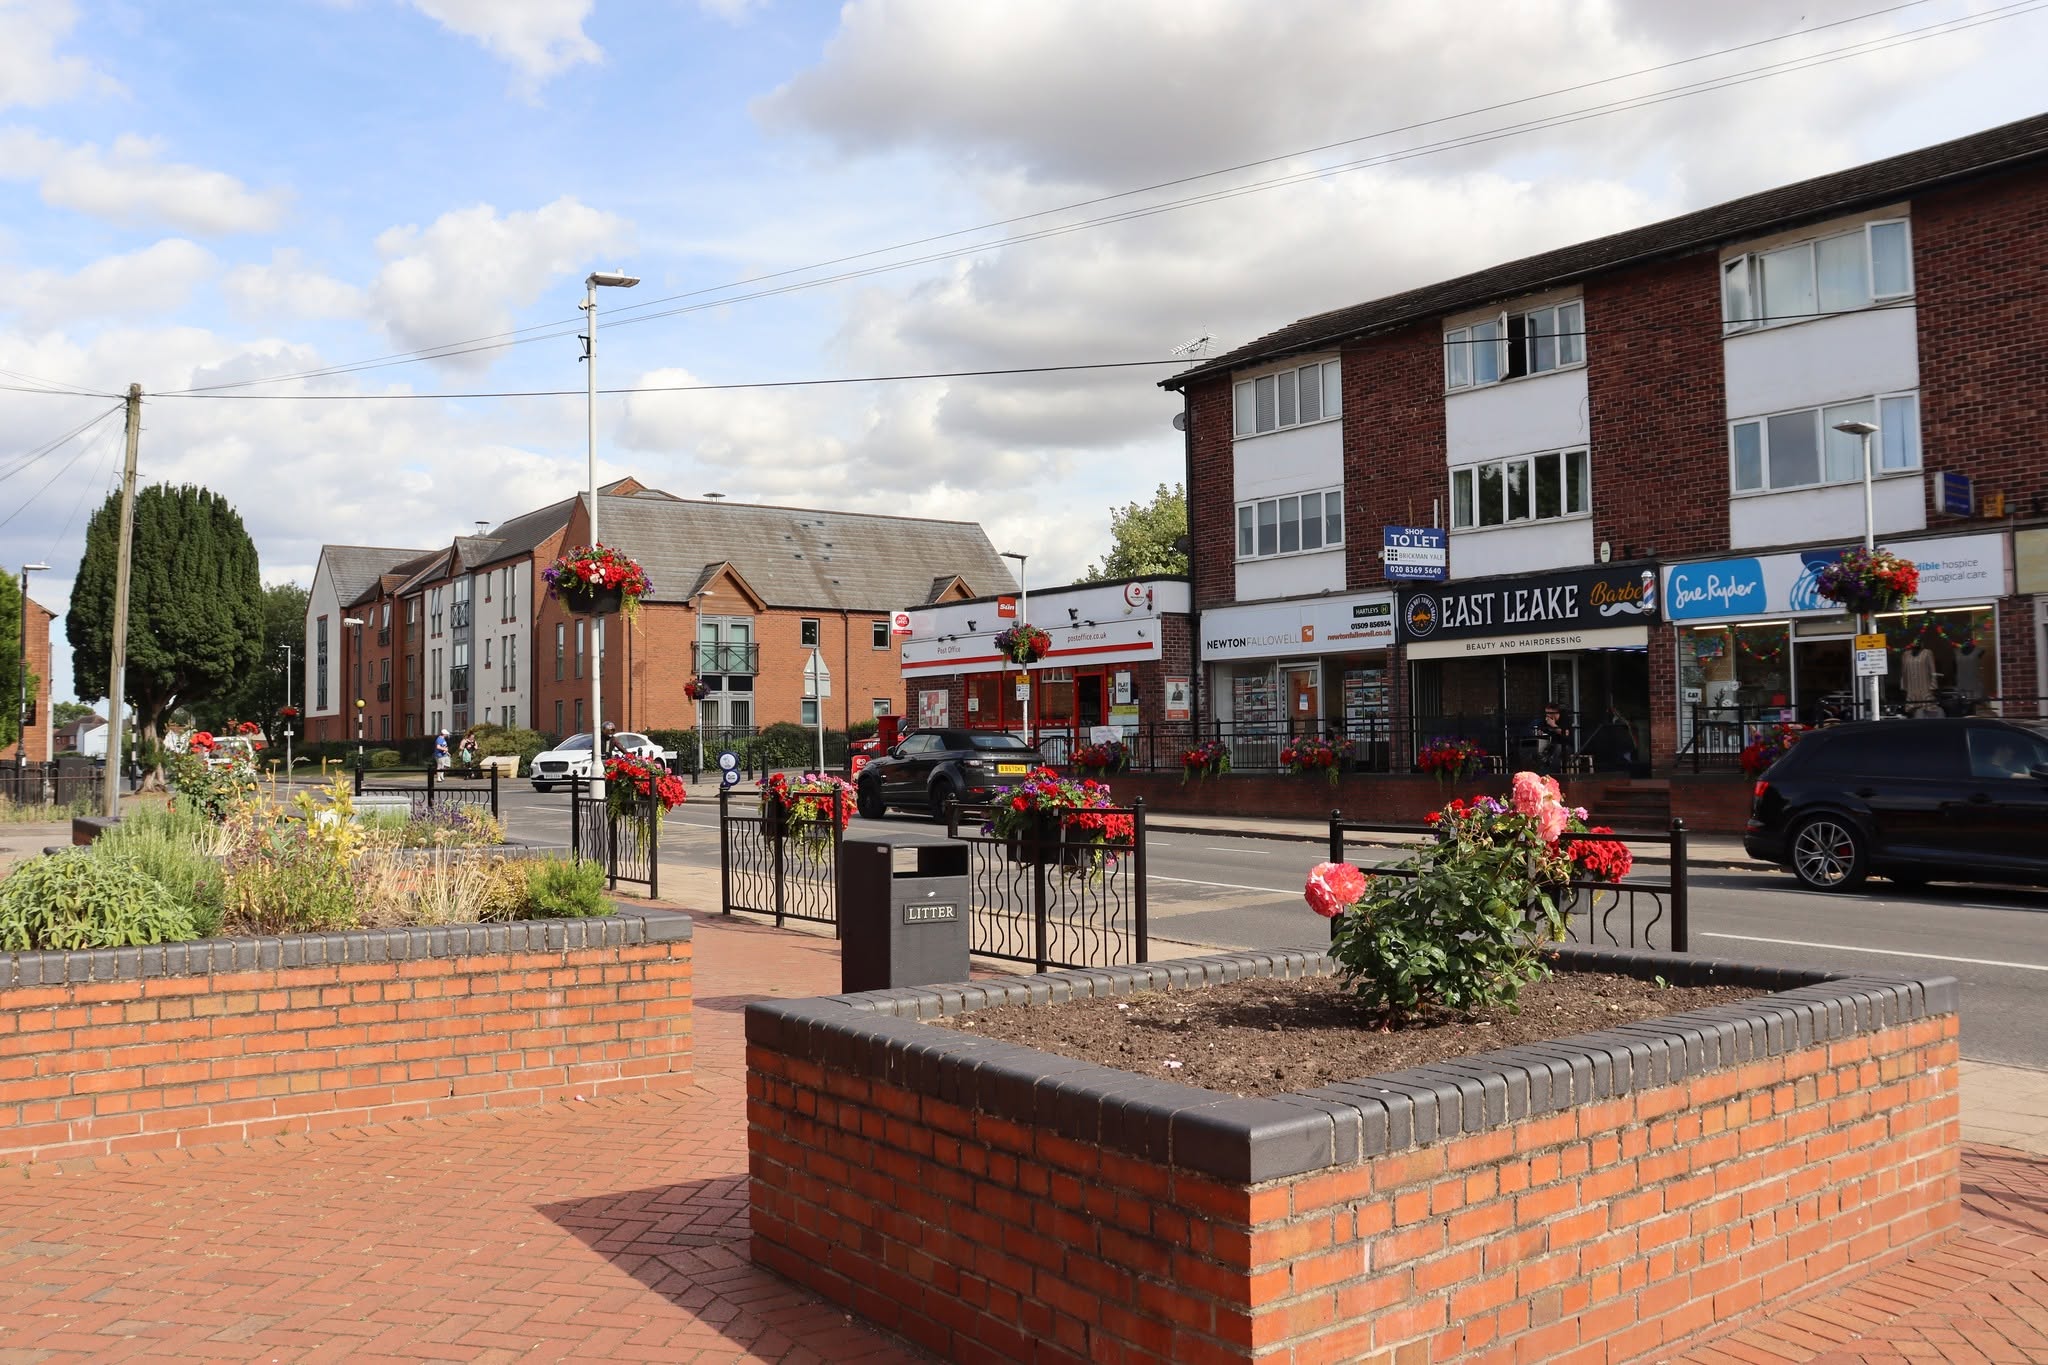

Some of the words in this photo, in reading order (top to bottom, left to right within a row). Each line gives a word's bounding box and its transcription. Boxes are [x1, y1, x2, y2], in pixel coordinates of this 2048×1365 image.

[1390, 534, 1410, 546] TO
[1414, 535, 1439, 548] LET
[1399, 552, 1428, 560] BRICKMAN
[1429, 553, 1443, 561] YALE
[1405, 566, 1423, 574] 8369
[1424, 567, 1442, 575] 5640
[1917, 561, 1941, 571] dible
[1942, 559, 1979, 569] hospice
[1918, 571, 1965, 583] urological
[1966, 570, 1988, 580] care
[1590, 580, 1643, 606] Barbe
[1675, 574, 1707, 609] Sue
[1707, 574, 1757, 609] Ryder
[999, 603, 1015, 611] Sun
[1355, 607, 1379, 616] HARTLEYS
[1441, 592, 1495, 628] EAST
[1503, 585, 1579, 623] LEAKE
[1351, 622, 1369, 630] 01509
[1067, 632, 1107, 643] postoffice.co.uk
[1327, 630, 1392, 641] newtonfallowell.co.uk
[1466, 642, 1496, 651] BEAUTY
[1500, 640, 1516, 648] AND
[1519, 636, 1582, 647] HAIRDRESSING
[937, 647, 947, 655] Post
[948, 645, 960, 653] Office
[909, 906, 954, 920] LITTER
